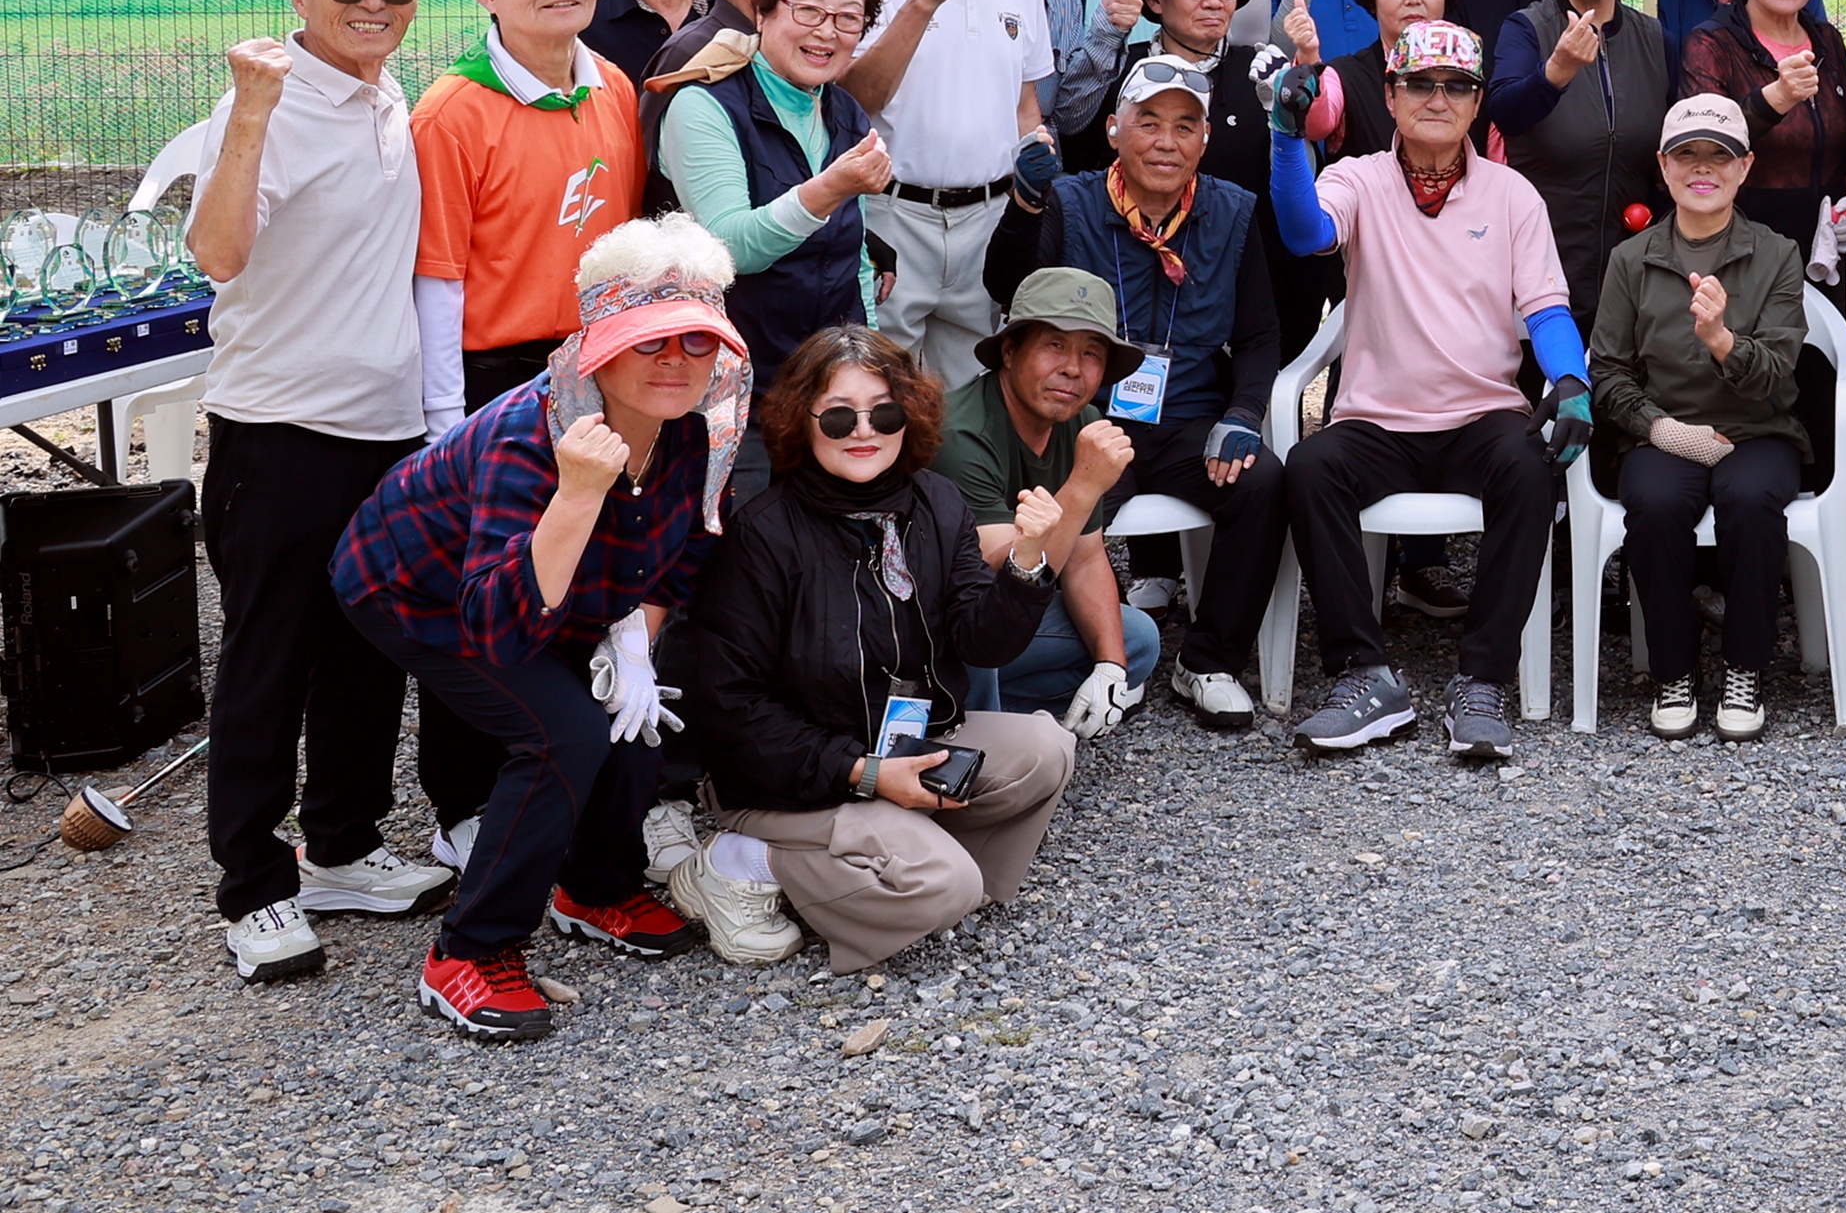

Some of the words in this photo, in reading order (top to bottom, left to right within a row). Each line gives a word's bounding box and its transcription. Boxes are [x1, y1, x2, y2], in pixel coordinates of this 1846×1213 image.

[1407, 26, 1476, 62] NETS
[1123, 379, 1156, 396] 심판위원
[19, 572, 33, 625] Roland
